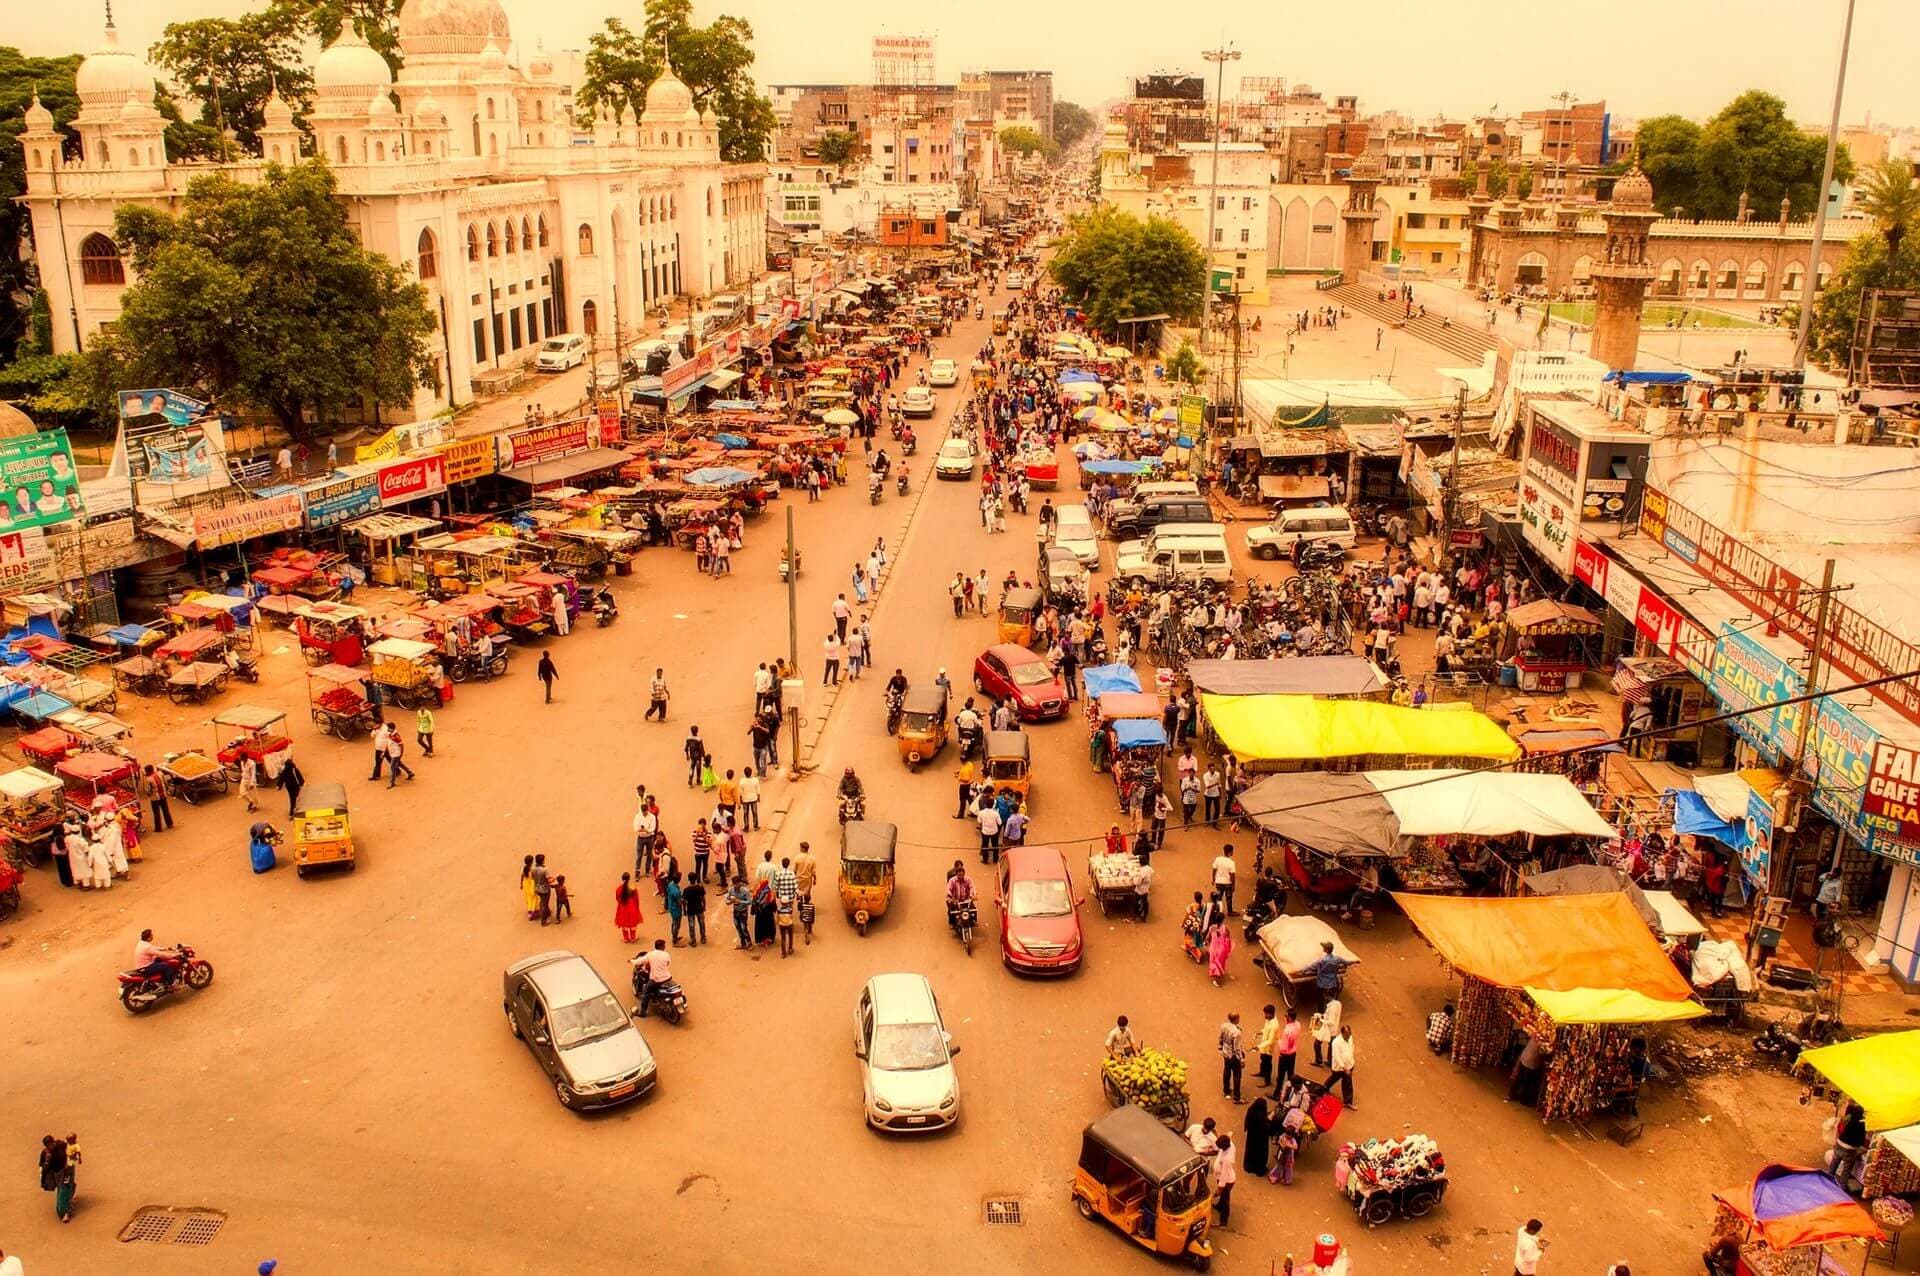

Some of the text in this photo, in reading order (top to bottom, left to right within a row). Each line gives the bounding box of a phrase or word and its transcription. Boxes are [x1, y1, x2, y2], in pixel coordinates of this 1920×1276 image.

[875, 39, 909, 48] BHASKAR
[514, 428, 560, 447] MUQADDAR
[560, 422, 586, 437] HOTEL
[1534, 423, 1581, 475] NIMRAH
[354, 473, 378, 489] BAKERY
[201, 512, 251, 532] SADDAM
[1702, 523, 1725, 562] CAFE
[1731, 542, 1774, 590] BAKERY
[1714, 652, 1777, 713] PEARLS
[1869, 776, 1920, 806] CAFE
[1865, 814, 1897, 832] VEG
